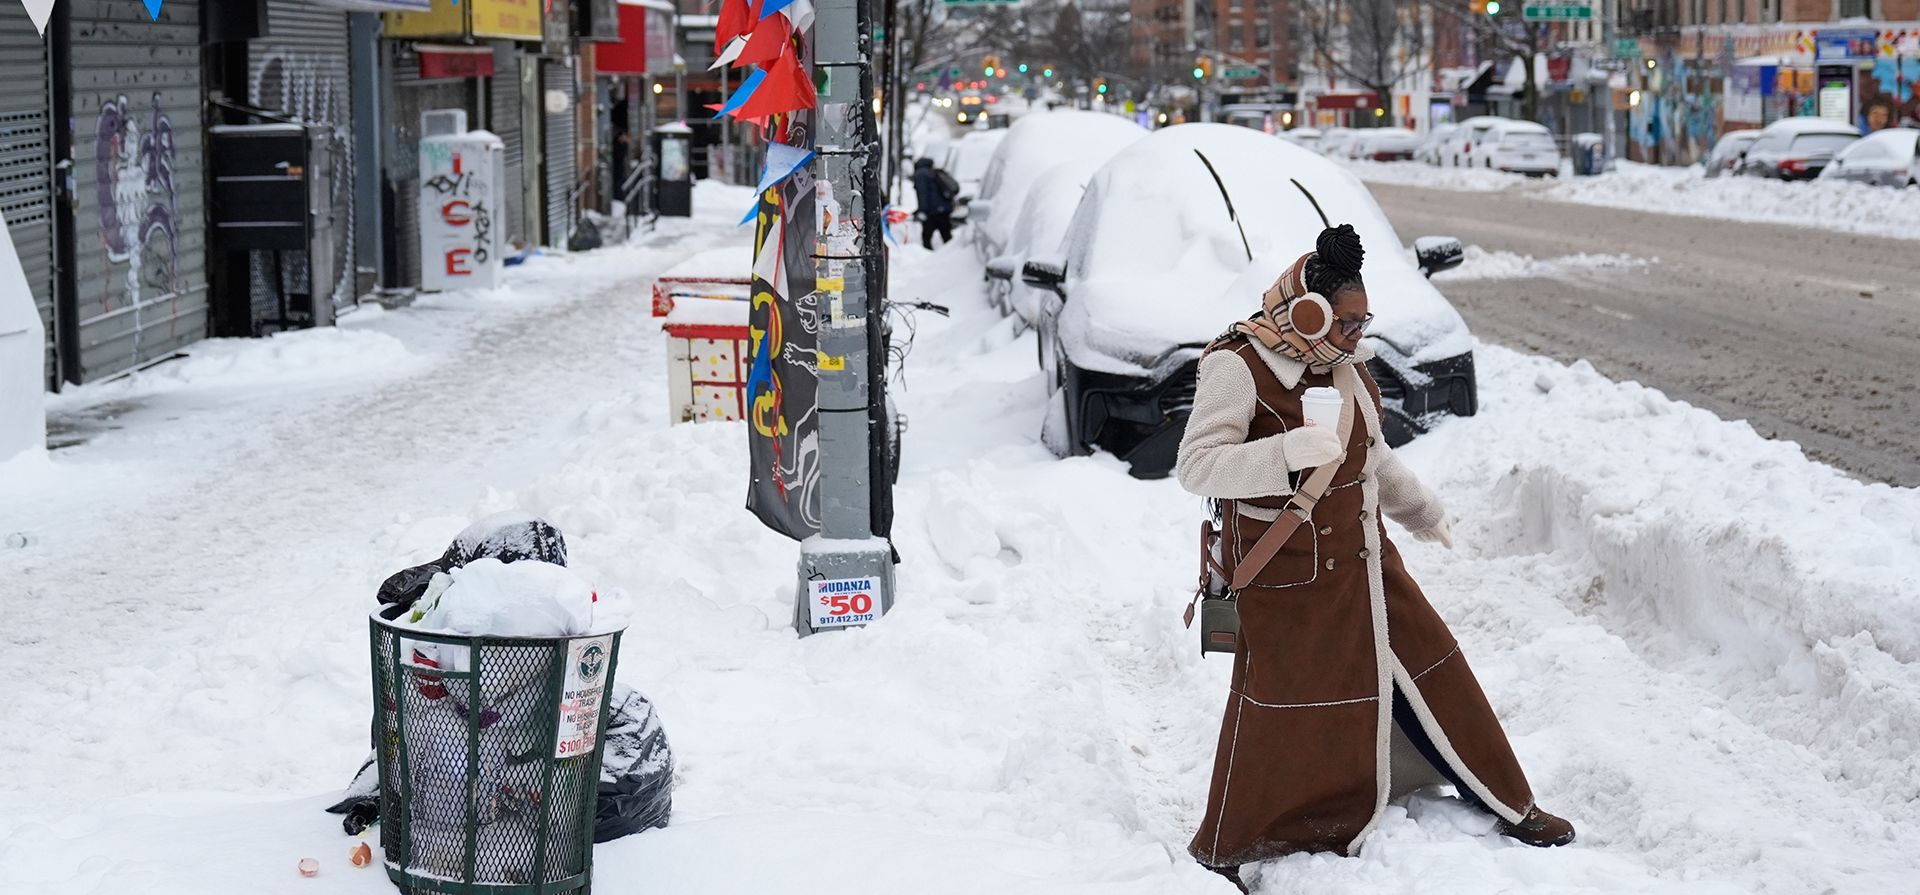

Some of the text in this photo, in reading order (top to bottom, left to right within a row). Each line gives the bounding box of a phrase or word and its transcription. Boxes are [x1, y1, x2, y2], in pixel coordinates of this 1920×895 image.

[441, 152, 472, 276] ICE
[818, 580, 871, 593] MUDANZA
[820, 594, 872, 615] $50
[820, 614, 873, 624] 917.412.3712
[565, 691, 575, 699] NO
[566, 714, 576, 724] NO
